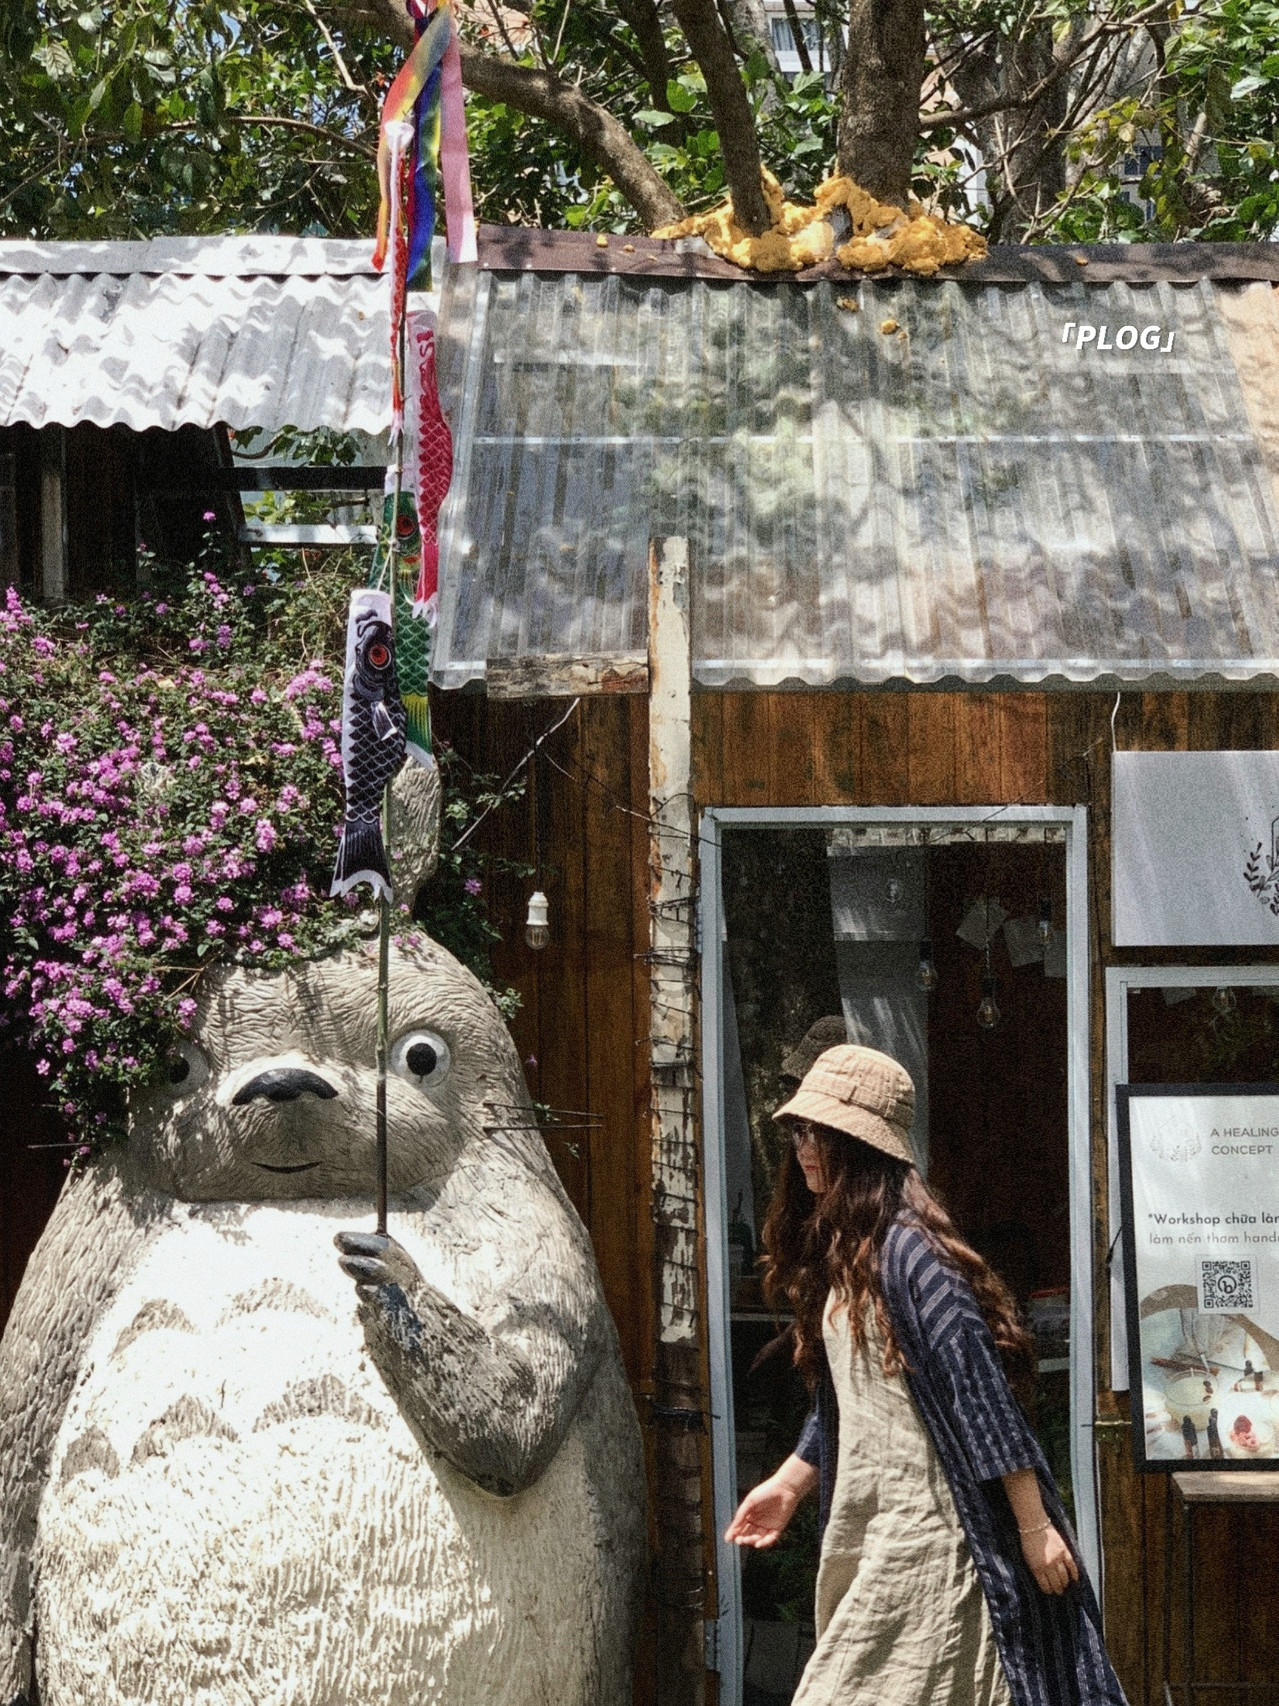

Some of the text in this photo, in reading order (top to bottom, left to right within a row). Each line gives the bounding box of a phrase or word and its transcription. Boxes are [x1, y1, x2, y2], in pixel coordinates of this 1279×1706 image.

[1211, 1127, 1279, 1137] A HEALING
[1211, 1144, 1273, 1155] CONCEPT
[1244, 1231, 1279, 1244] hand
